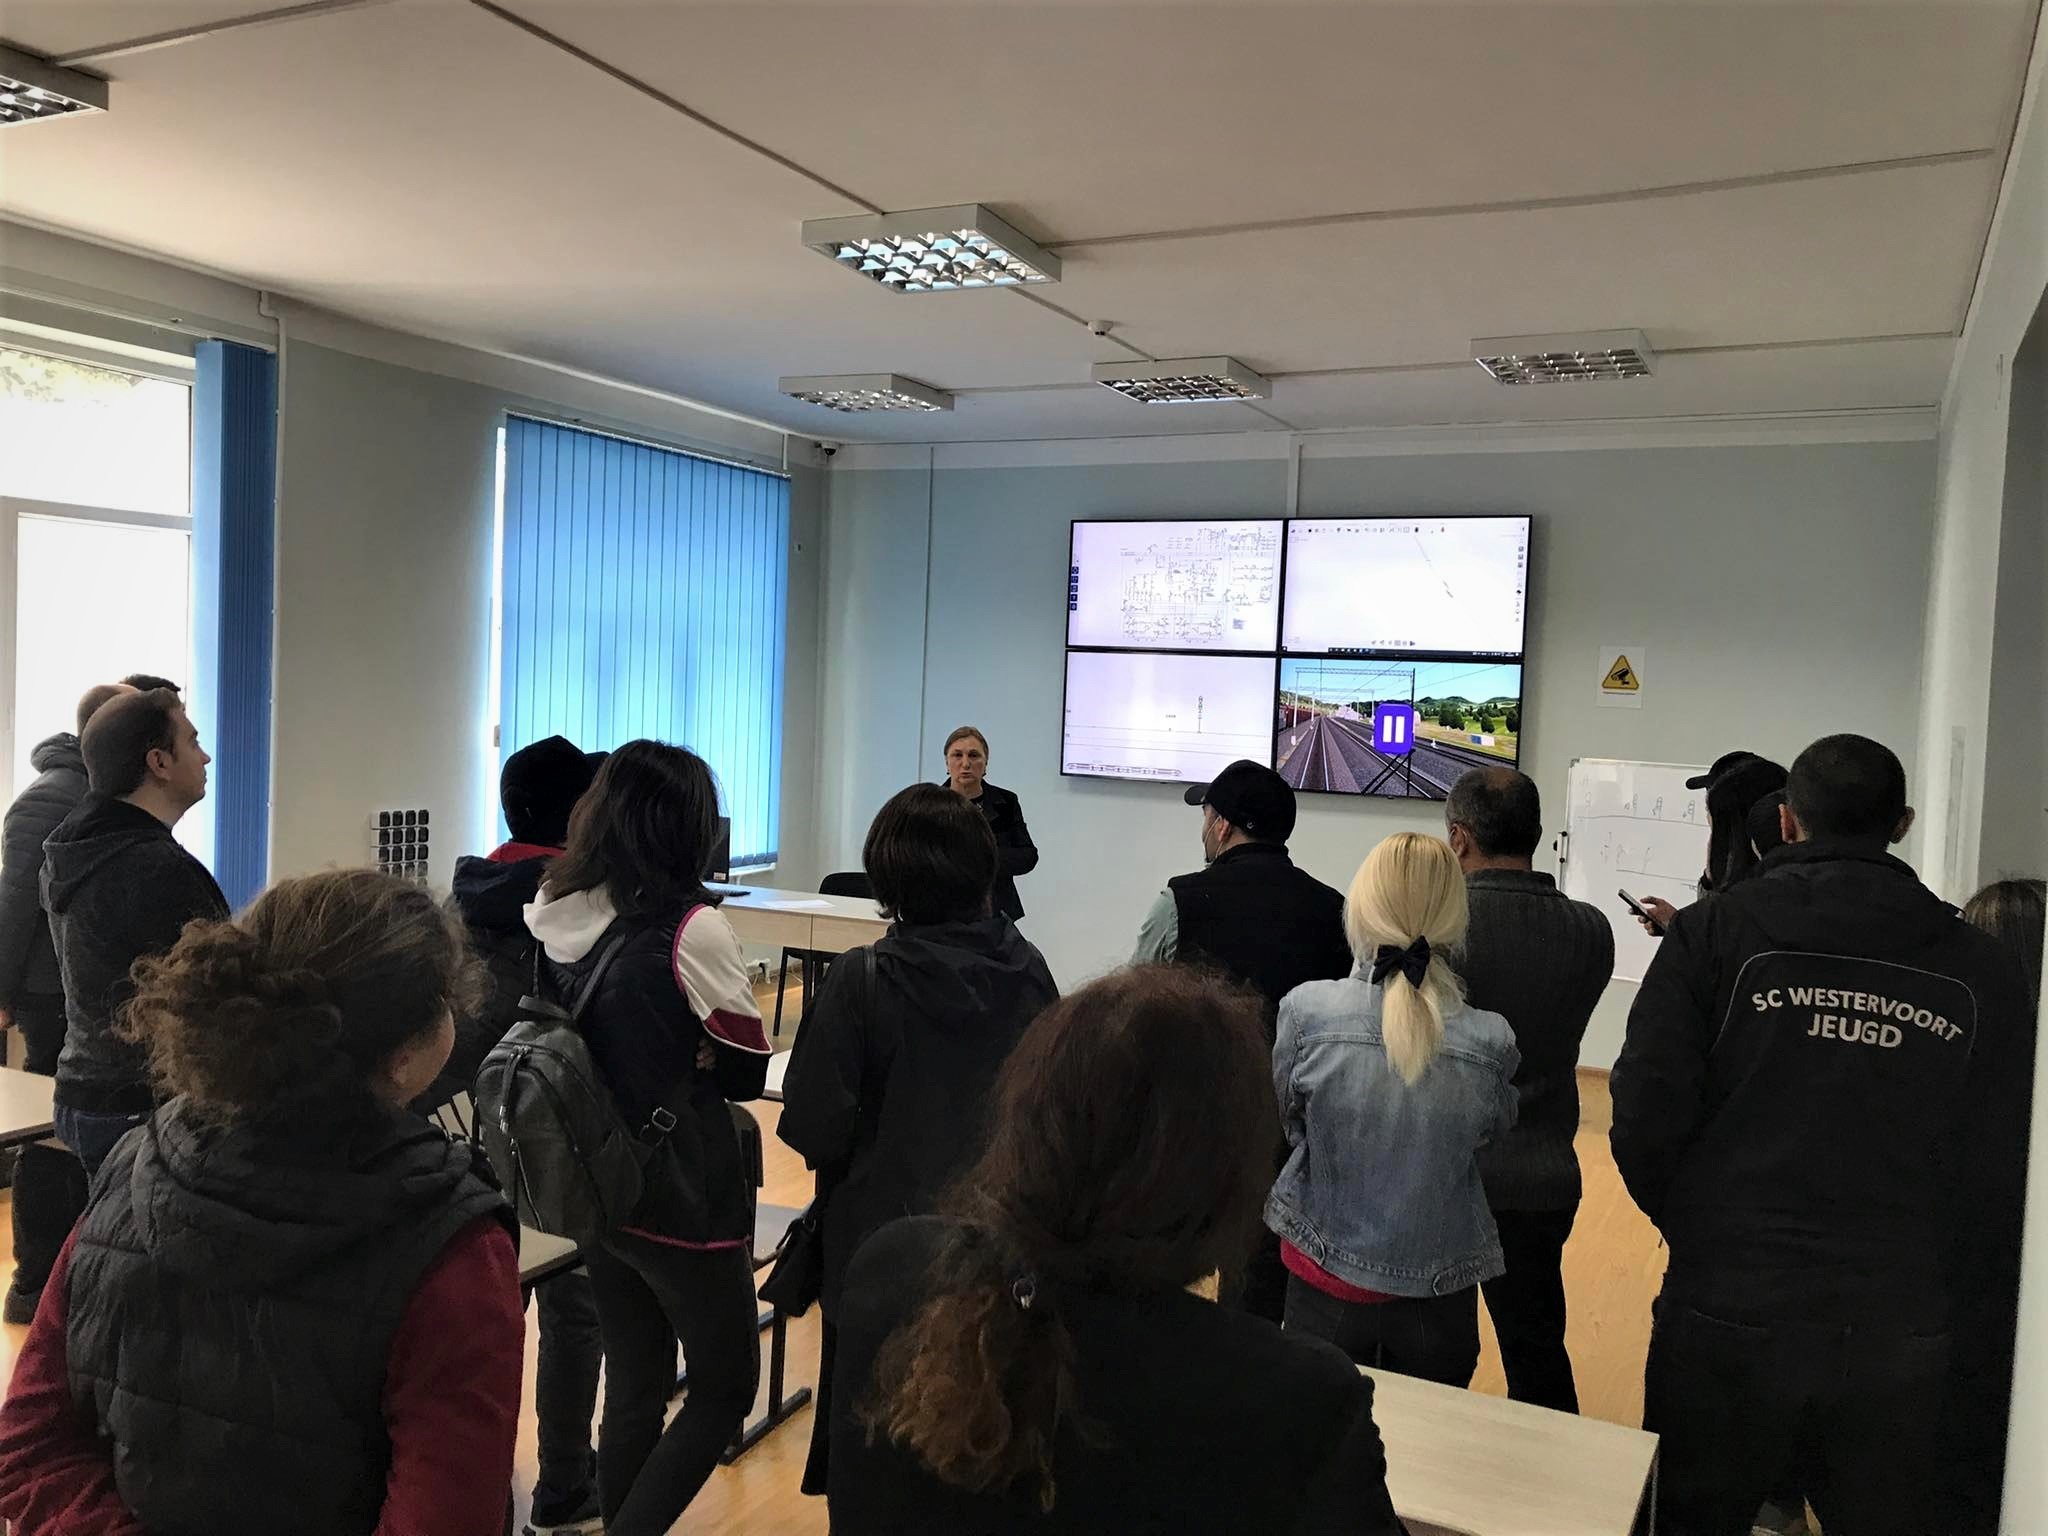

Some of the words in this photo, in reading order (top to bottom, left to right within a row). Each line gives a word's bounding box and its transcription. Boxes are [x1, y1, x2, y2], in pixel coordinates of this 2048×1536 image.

[1751, 989, 1783, 1012] SC
[1788, 987, 1963, 1042] WESTERVOORT
[1807, 1013, 1903, 1048] JEUGD
